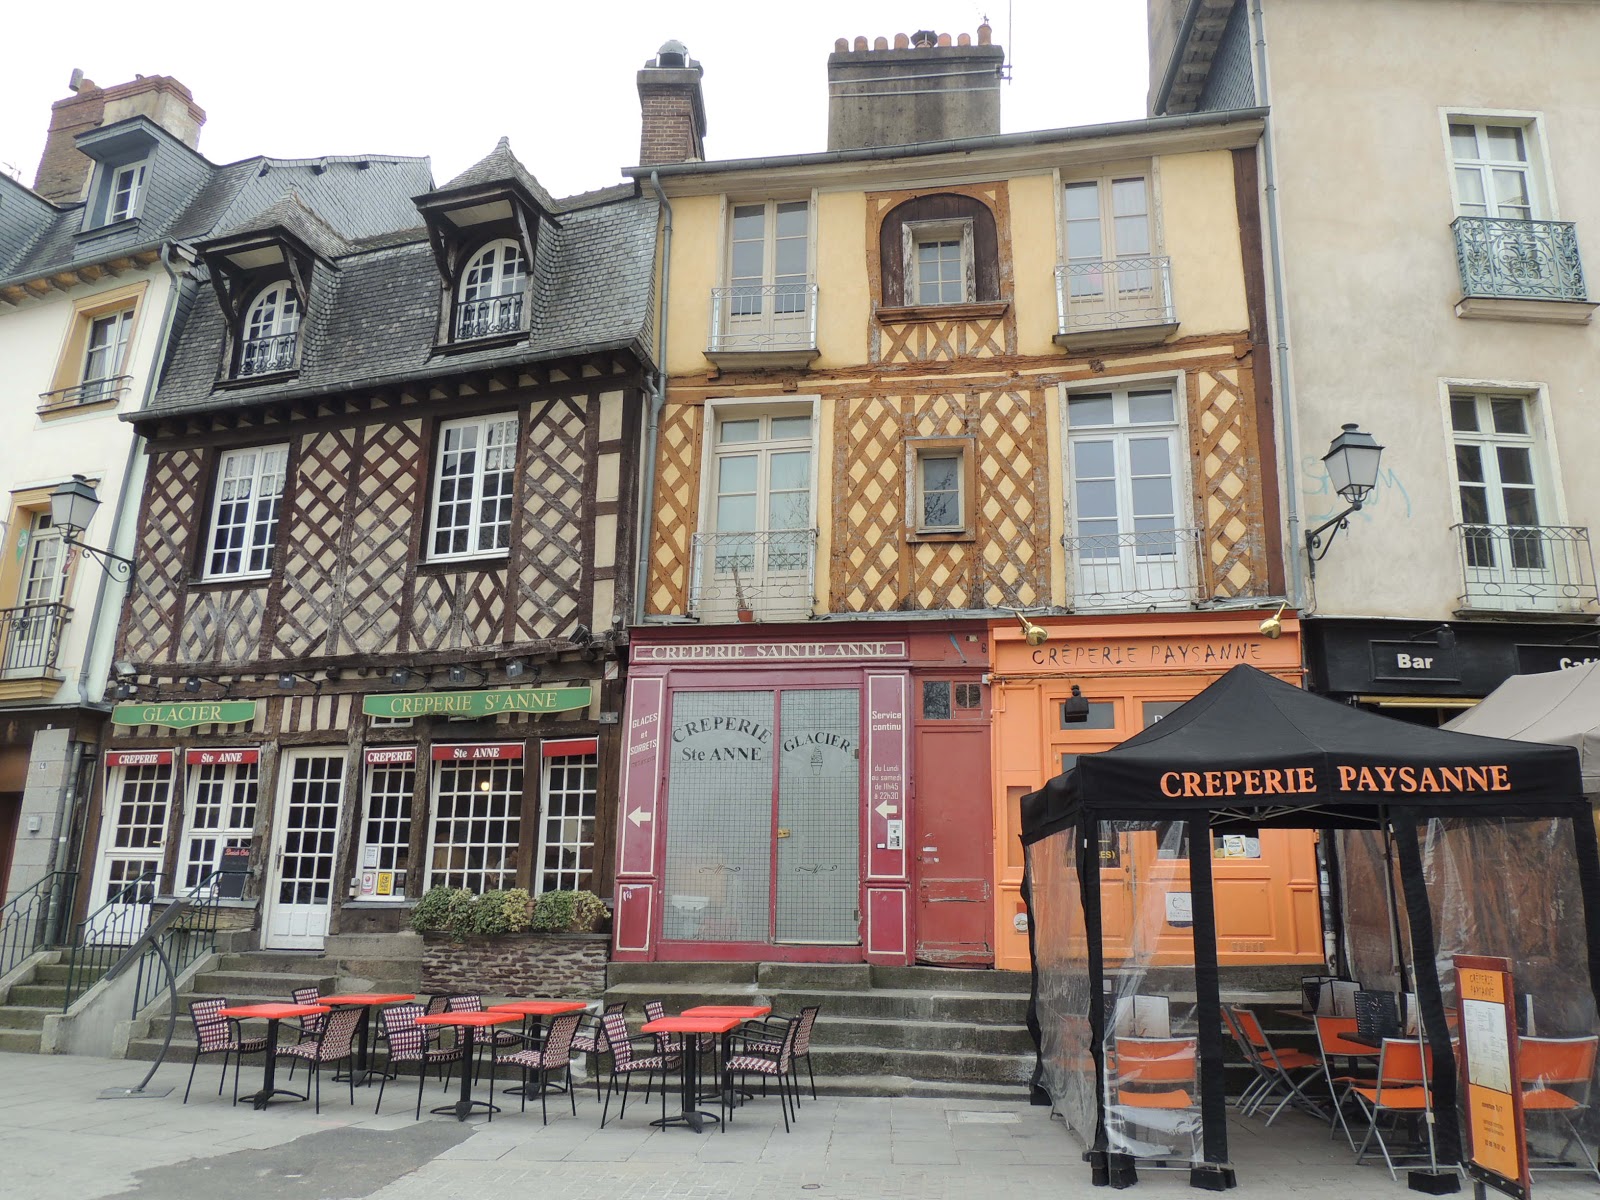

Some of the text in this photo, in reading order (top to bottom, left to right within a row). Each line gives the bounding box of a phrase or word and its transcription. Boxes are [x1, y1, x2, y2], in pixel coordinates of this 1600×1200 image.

[651, 643, 887, 659] CREPERIE SAINTE ANNE
[1032, 643, 1262, 666] CRÊPERIE PAYSANNE
[1397, 654, 1433, 669] Bar
[390, 695, 472, 713] CREPERIE
[502, 692, 557, 710] ANNE
[142, 704, 222, 722] GLACIER
[606, 714, 611, 722] 5
[632, 712, 658, 728] GLACES
[872, 710, 902, 720] Service
[640, 730, 648, 738] et
[672, 716, 772, 744] CREPERIE
[630, 739, 656, 756] SORBETS
[783, 732, 851, 753] GLACIER
[118, 754, 158, 764] CREPERIE
[201, 753, 242, 762] Ste ANNE
[367, 752, 412, 762] CREPERIE
[453, 748, 500, 758] Ste ANNE
[682, 746, 762, 762] Ste ANNE
[1160, 765, 1512, 798] CREPERIE PAYSANNE
[880, 792, 898, 800] 22h30
